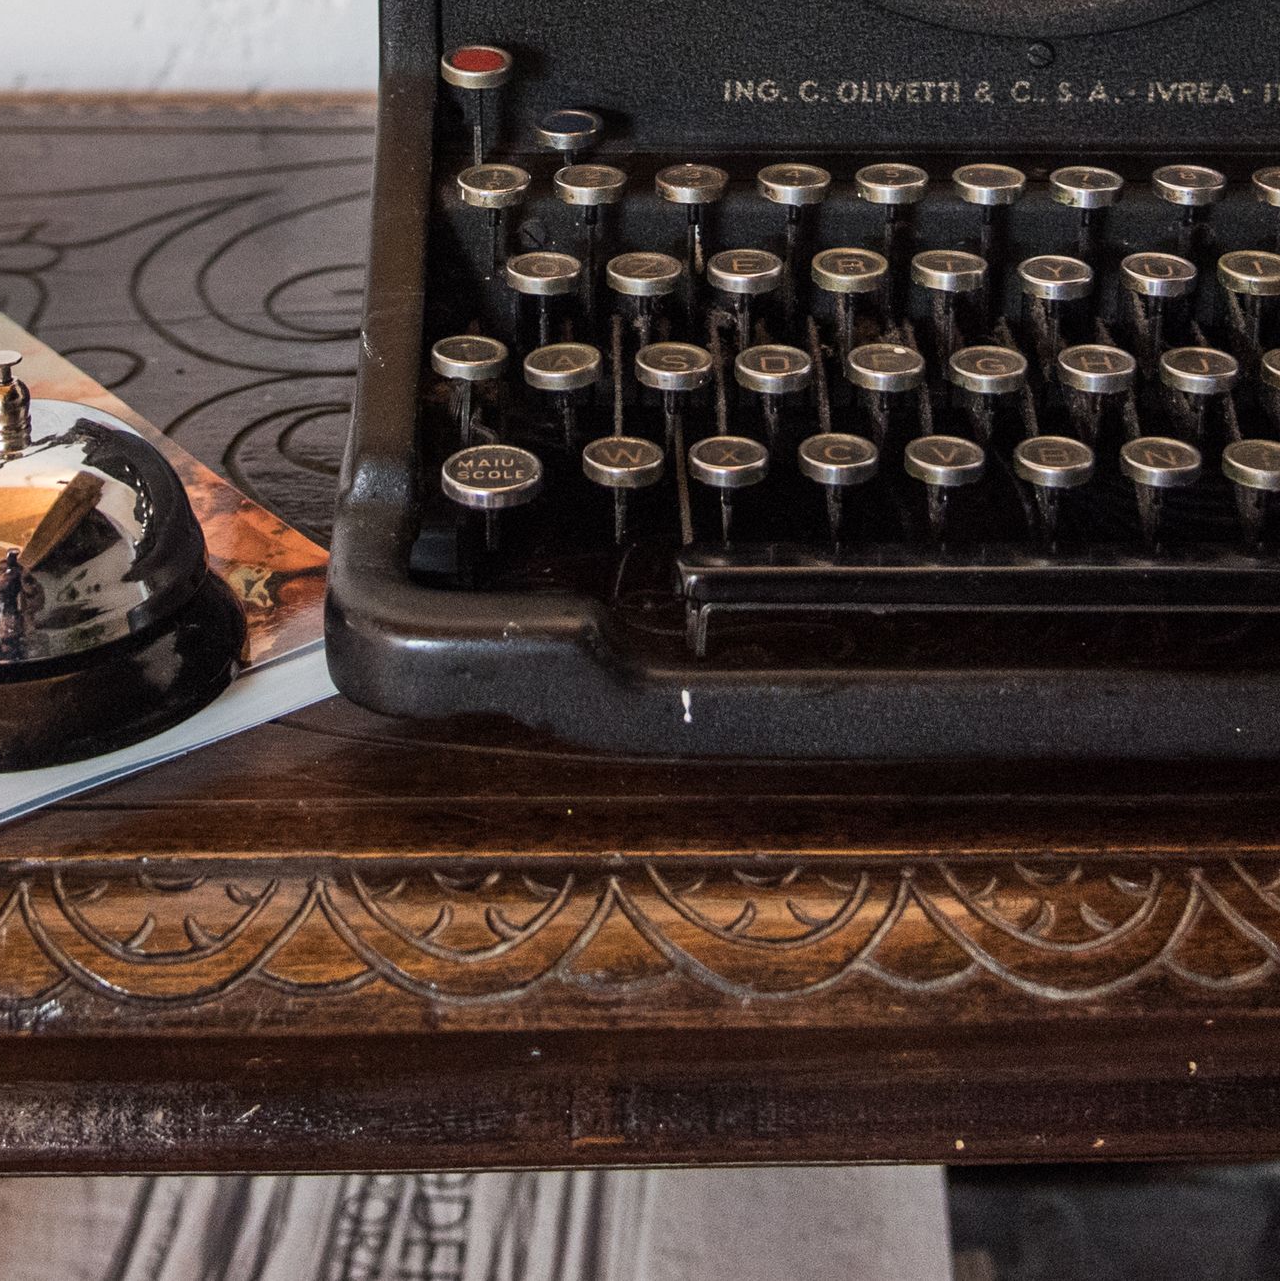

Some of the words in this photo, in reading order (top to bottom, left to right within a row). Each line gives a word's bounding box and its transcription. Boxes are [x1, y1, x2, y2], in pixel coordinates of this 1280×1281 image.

[723, 78, 789, 103] ING.
[798, 79, 829, 103] C.
[836, 79, 961, 104] OLIVETTI
[973, 80, 995, 104] &
[1146, 79, 1236, 105] IVREA
[731, 258, 760, 272] E
[837, 258, 867, 274] R
[1040, 265, 1064, 278] Y
[1143, 264, 1173, 278] U
[550, 354, 578, 368] A
[660, 354, 689, 369] S
[759, 355, 791, 371] D
[975, 357, 1007, 373] G
[1080, 355, 1114, 371] H
[601, 447, 644, 464] W
[716, 448, 741, 464] X
[822, 445, 852, 461] C
[929, 447, 959, 463] V
[1038, 447, 1070, 465] B
[1144, 448, 1178, 466] N
[456, 469, 525, 480] SCOLE
